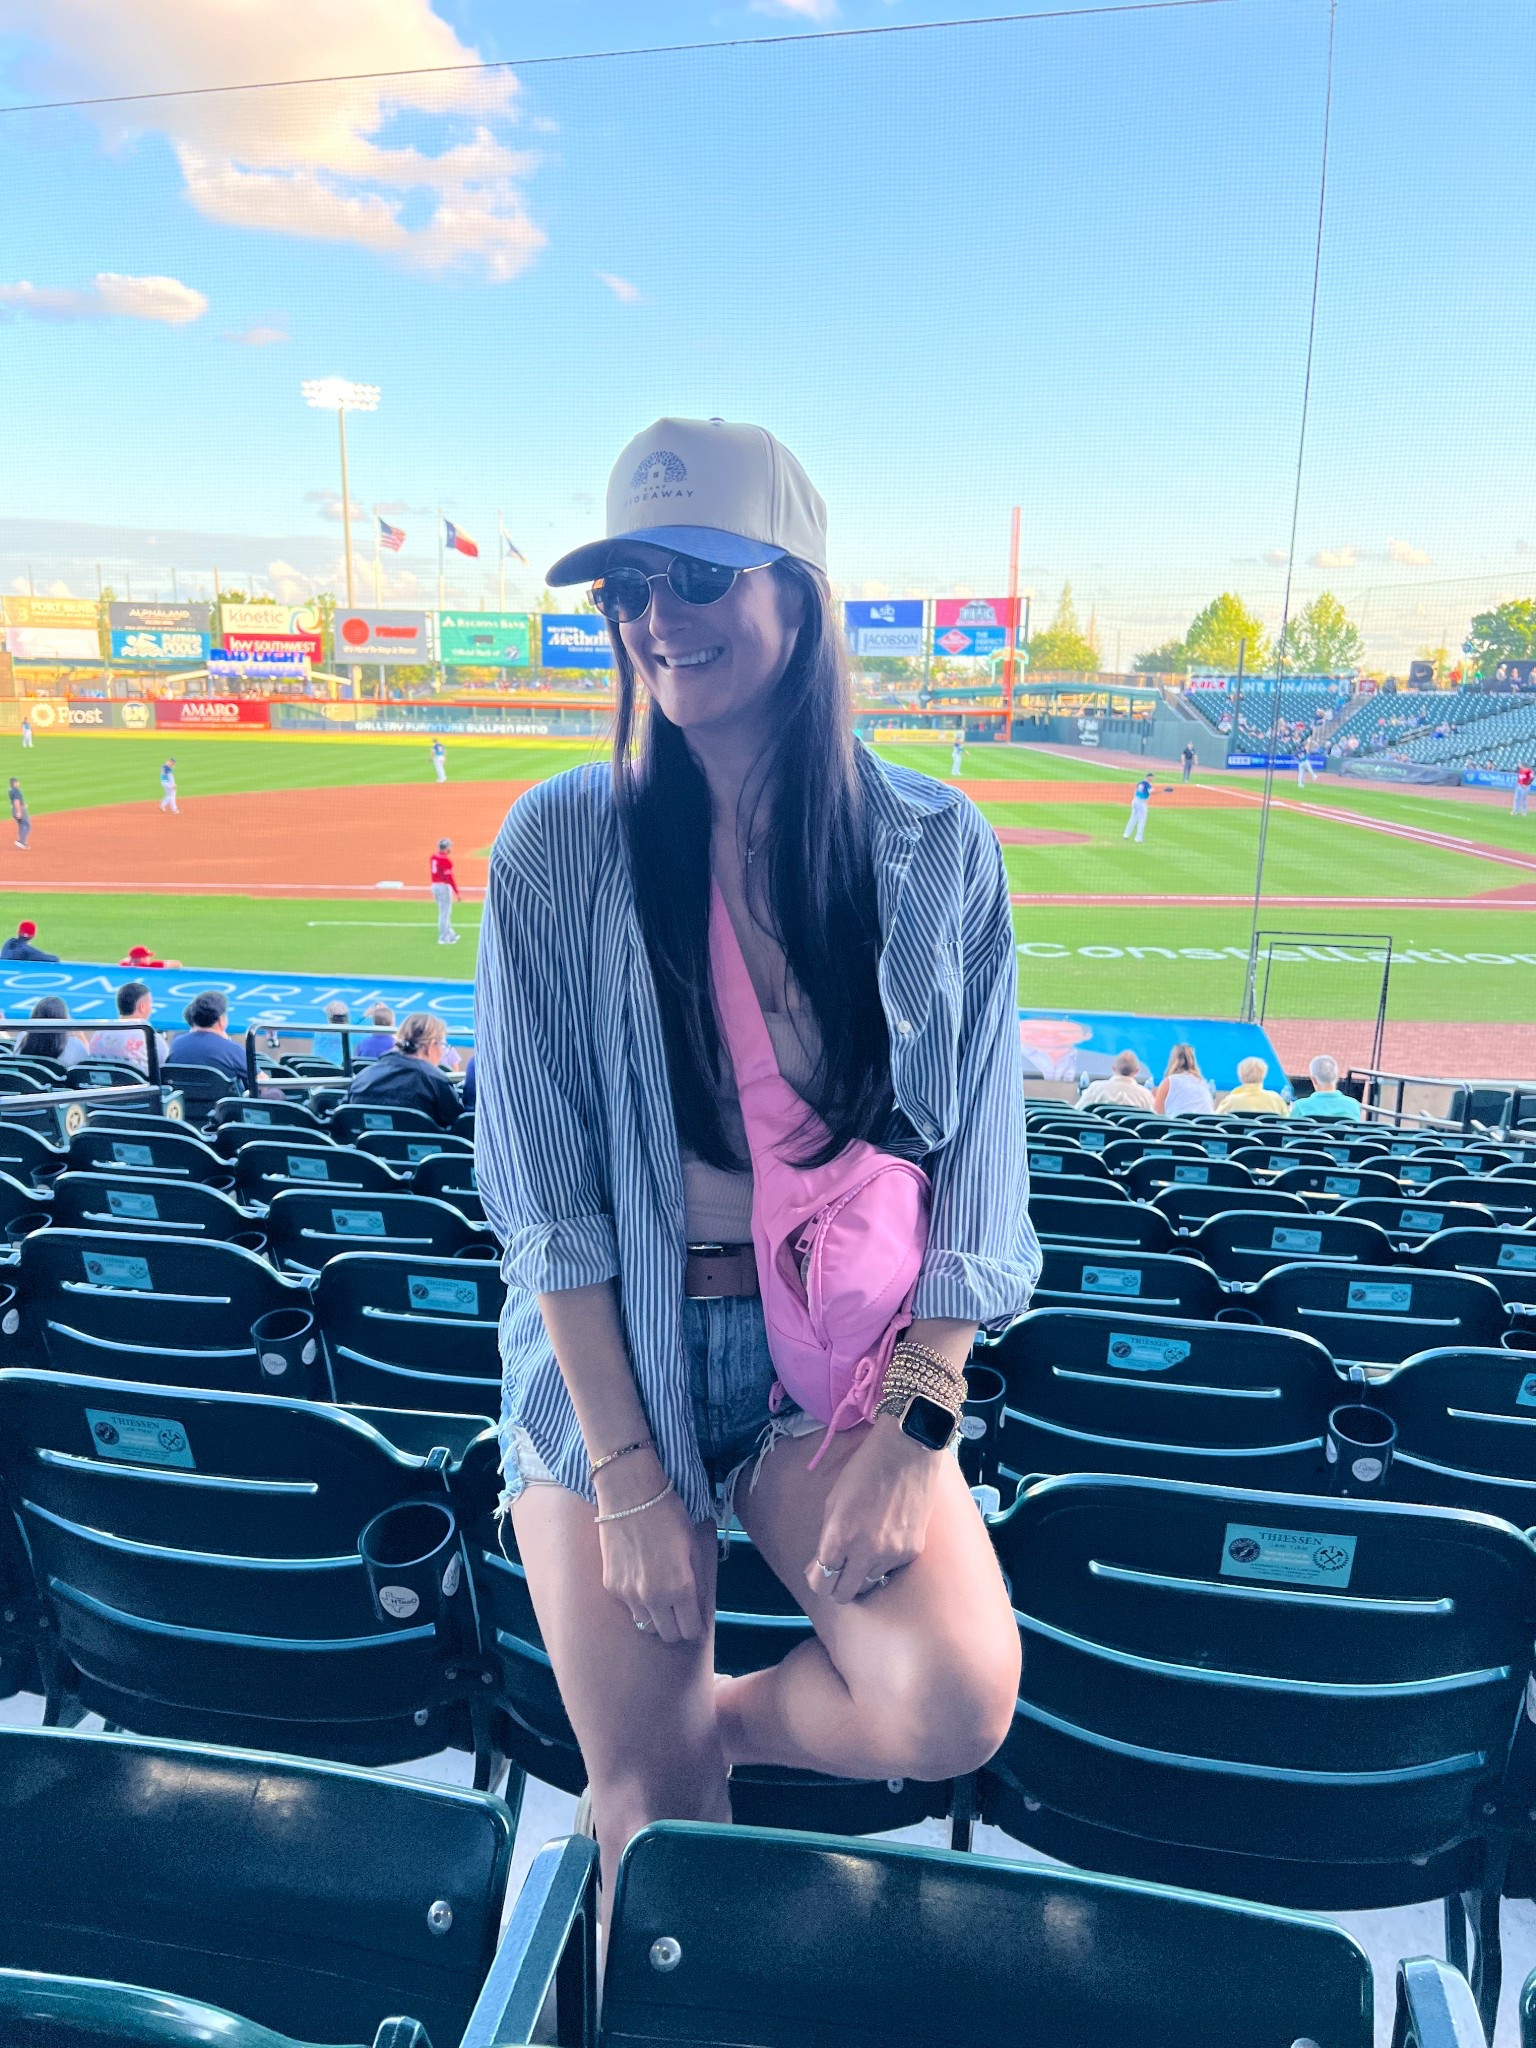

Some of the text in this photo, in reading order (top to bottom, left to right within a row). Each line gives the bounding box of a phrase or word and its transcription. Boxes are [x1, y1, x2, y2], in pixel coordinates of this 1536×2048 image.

[623, 489, 694, 508] HIDEAWAY
[128, 608, 191, 619] ALPHALAND
[549, 628, 612, 646] Methodi
[865, 633, 919, 646] JACOBSON
[163, 643, 203, 657] POOLS
[254, 640, 317, 654] SOUTHWEST
[58, 707, 103, 724] Frost
[181, 703, 239, 717] AMARO
[355, 722, 548, 735] GALLERY FURNITURE BULLPEN PATIO
[110, 1416, 160, 1429] THIESSEN
[1260, 1532, 1322, 1545] THIESSEN
